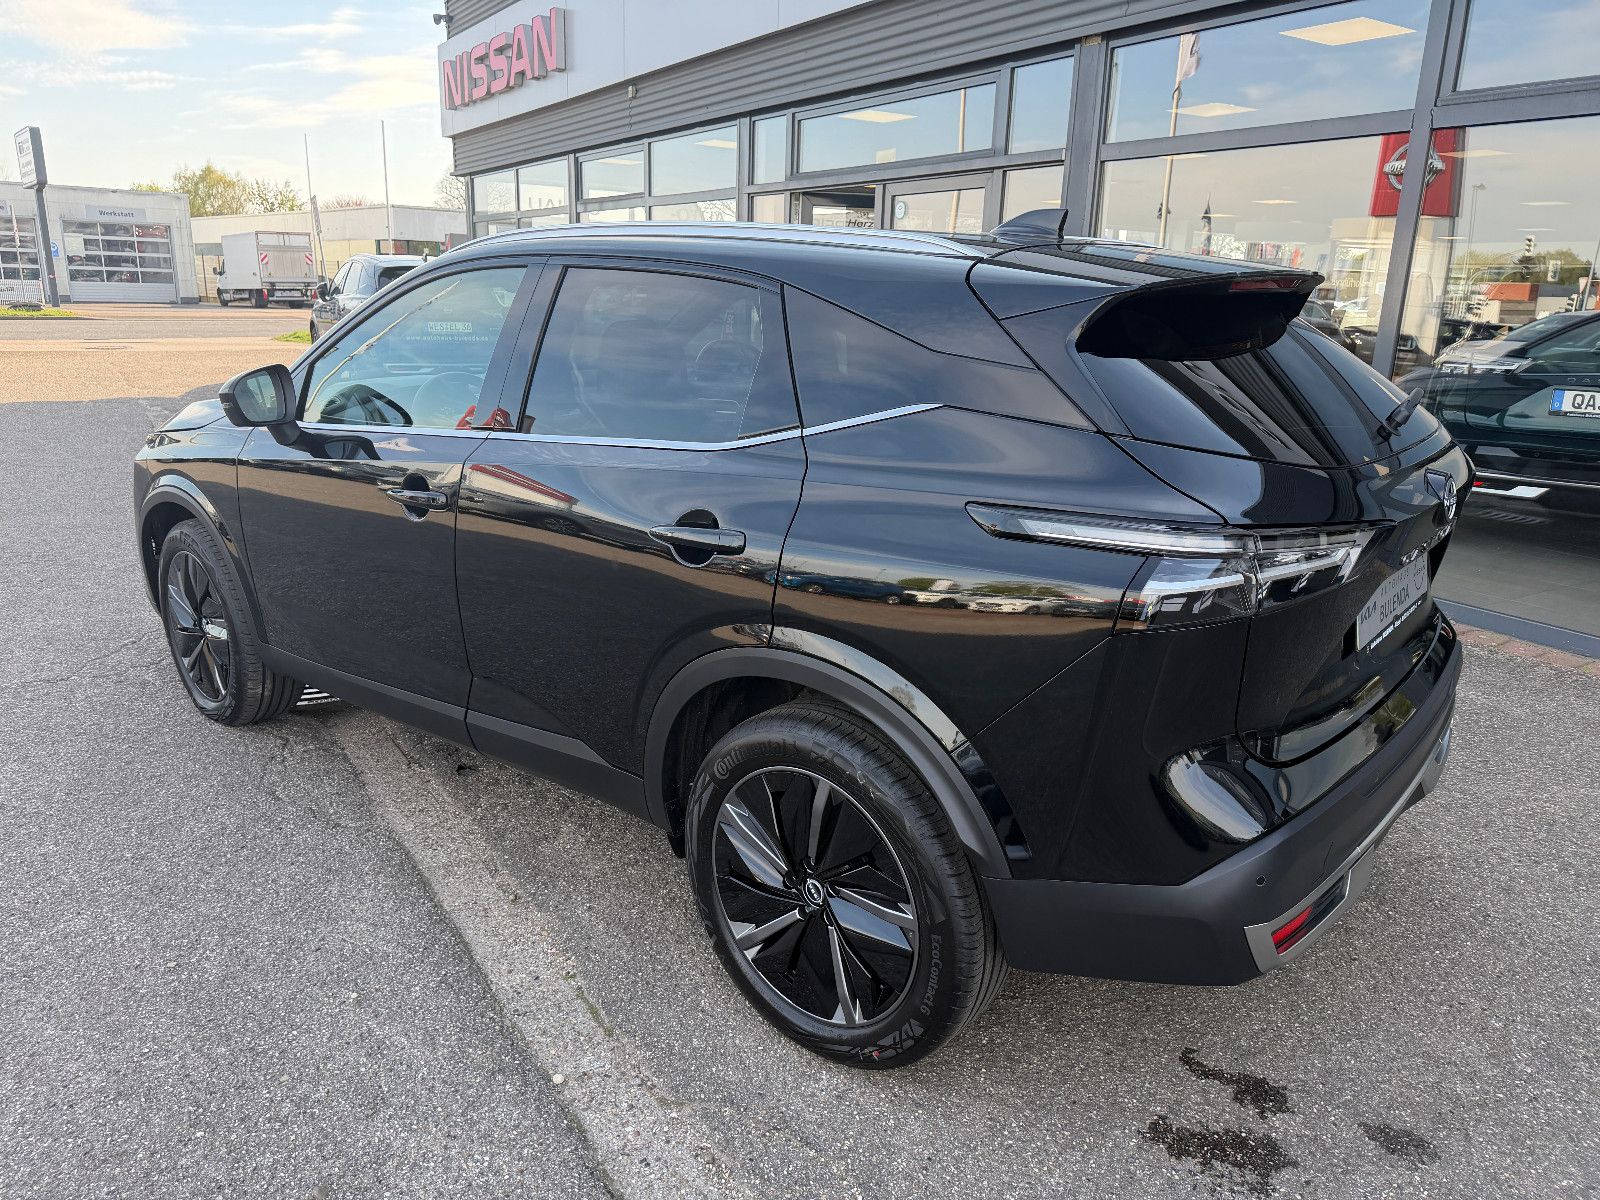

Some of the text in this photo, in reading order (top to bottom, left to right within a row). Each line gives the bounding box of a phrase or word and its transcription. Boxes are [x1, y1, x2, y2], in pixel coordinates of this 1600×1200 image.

[443, 7, 566, 111] NISSAN
[98, 209, 134, 218] Werkstatt
[1571, 393, 1600, 410] QA
[1379, 583, 1410, 623] BULENDA
[920, 933, 943, 1016] EcoContact 6
